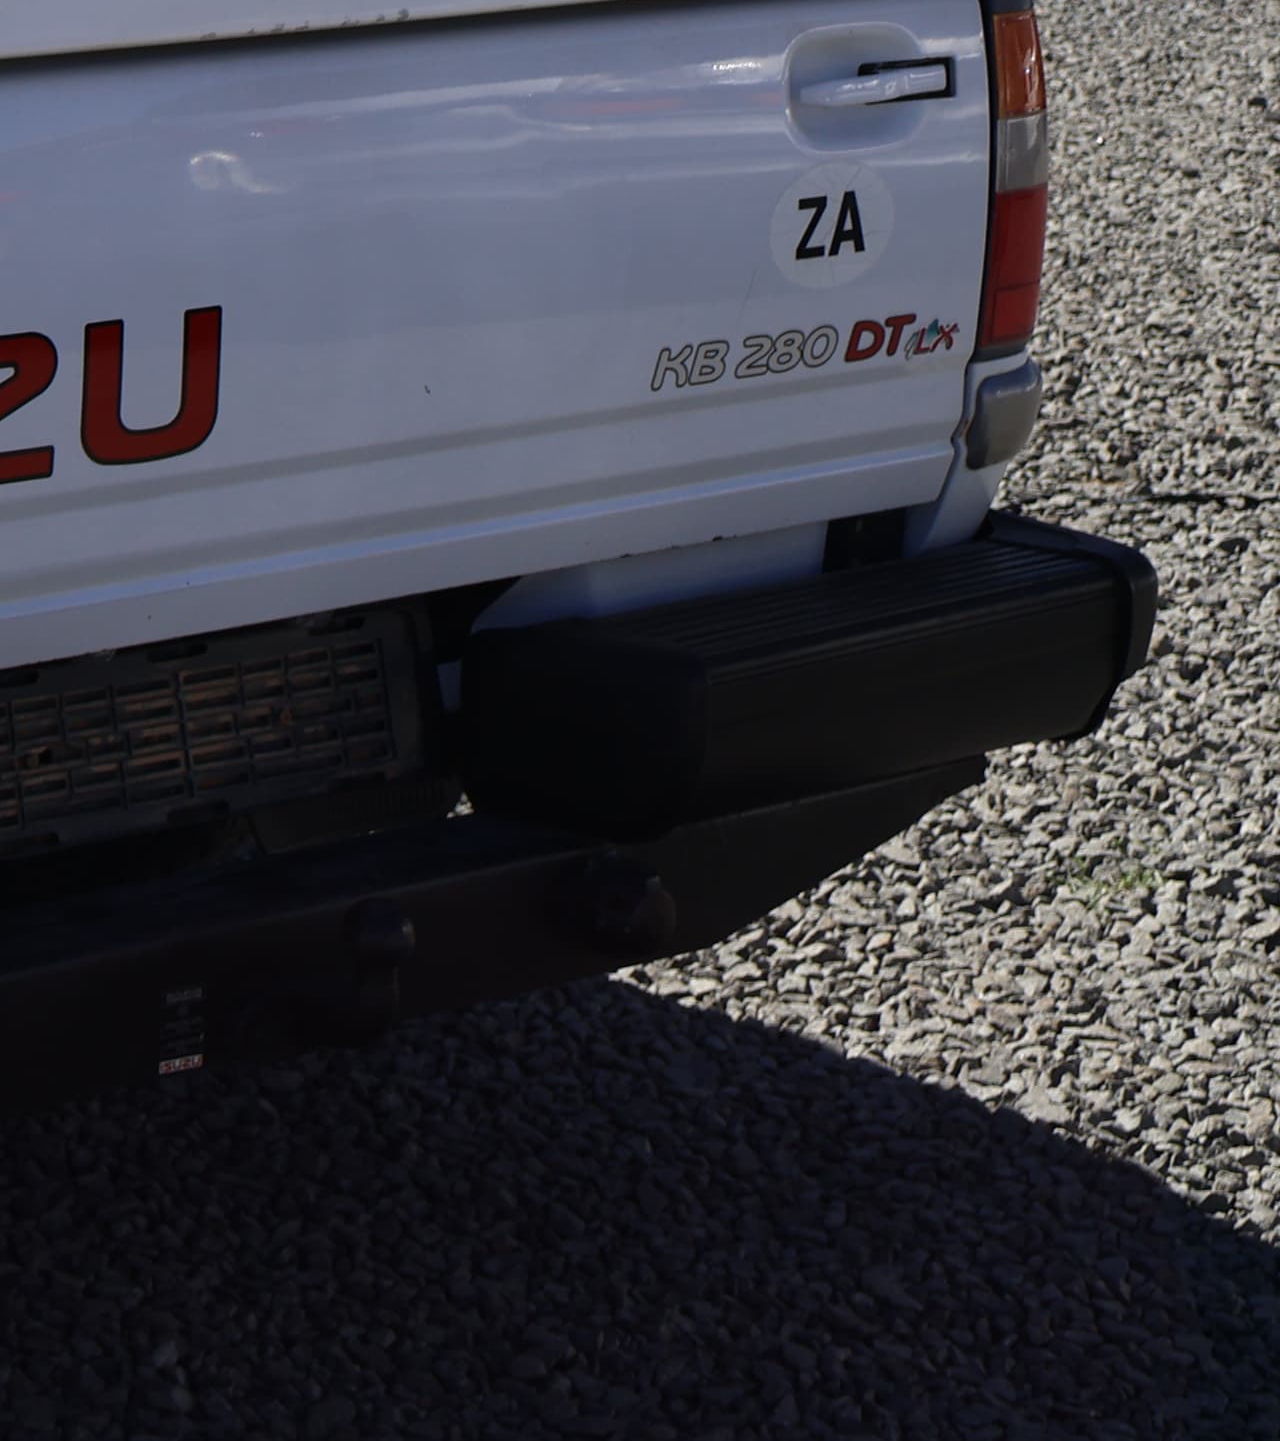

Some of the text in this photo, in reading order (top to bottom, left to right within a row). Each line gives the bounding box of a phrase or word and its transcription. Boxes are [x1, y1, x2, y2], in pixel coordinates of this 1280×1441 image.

[794, 189, 866, 261] ZA
[650, 338, 730, 392] KB
[734, 324, 839, 380] 280
